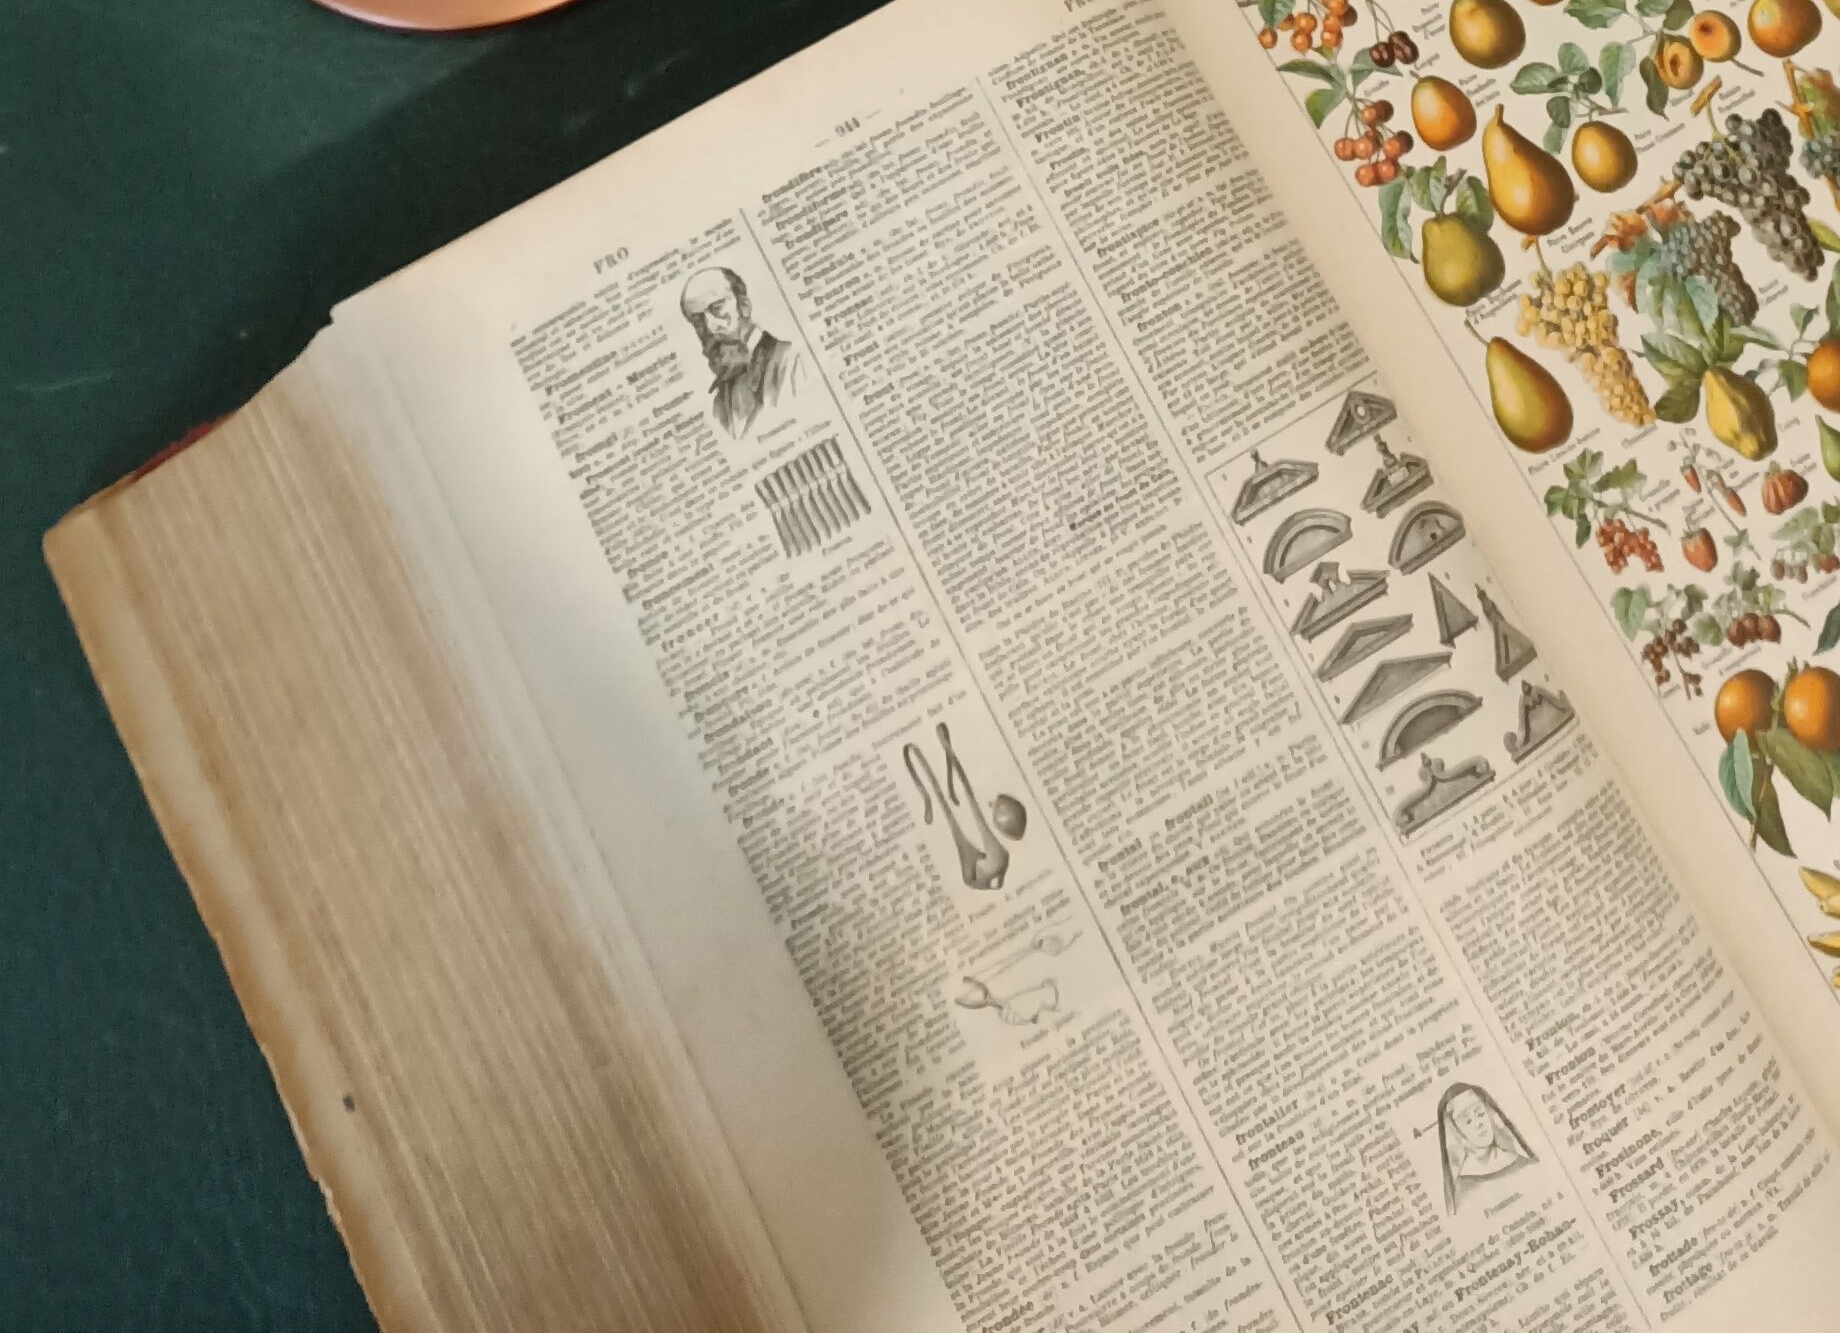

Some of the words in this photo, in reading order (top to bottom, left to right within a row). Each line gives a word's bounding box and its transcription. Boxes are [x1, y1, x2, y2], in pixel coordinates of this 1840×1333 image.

[593, 246, 630, 275] FRO
[1236, 1099, 1297, 1146] frontalier
[1583, 1117, 1628, 1155] froquer
[1248, 1130, 1304, 1171] fronteau
[1595, 1129, 1663, 1179] Frosinone,
[1609, 1157, 1664, 1203] Frossard
[1629, 1198, 1685, 1240] Frossay,
[1649, 1237, 1698, 1277] frottade
[1325, 1274, 1399, 1325] Frontenac
